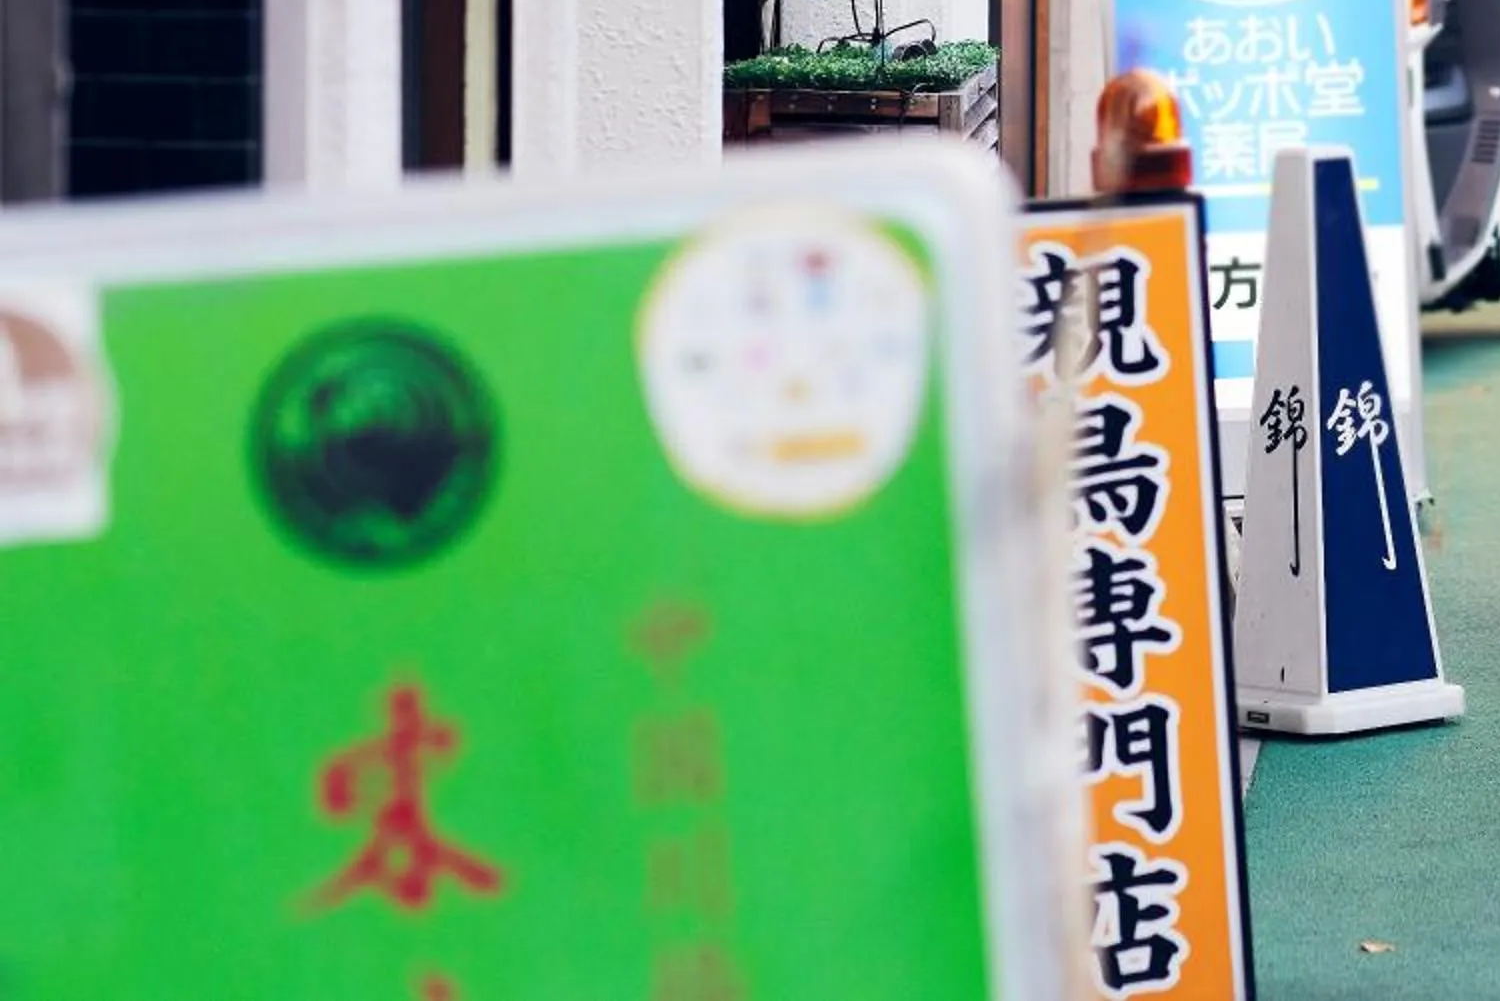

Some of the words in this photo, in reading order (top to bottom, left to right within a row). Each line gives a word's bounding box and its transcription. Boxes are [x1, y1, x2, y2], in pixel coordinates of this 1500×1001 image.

[1184, 13, 1335, 64] あおい
[1259, 385, 1308, 577] 錦
[1327, 380, 1397, 571] 錦
[1020, 251, 1179, 991] 親鳥専門店
